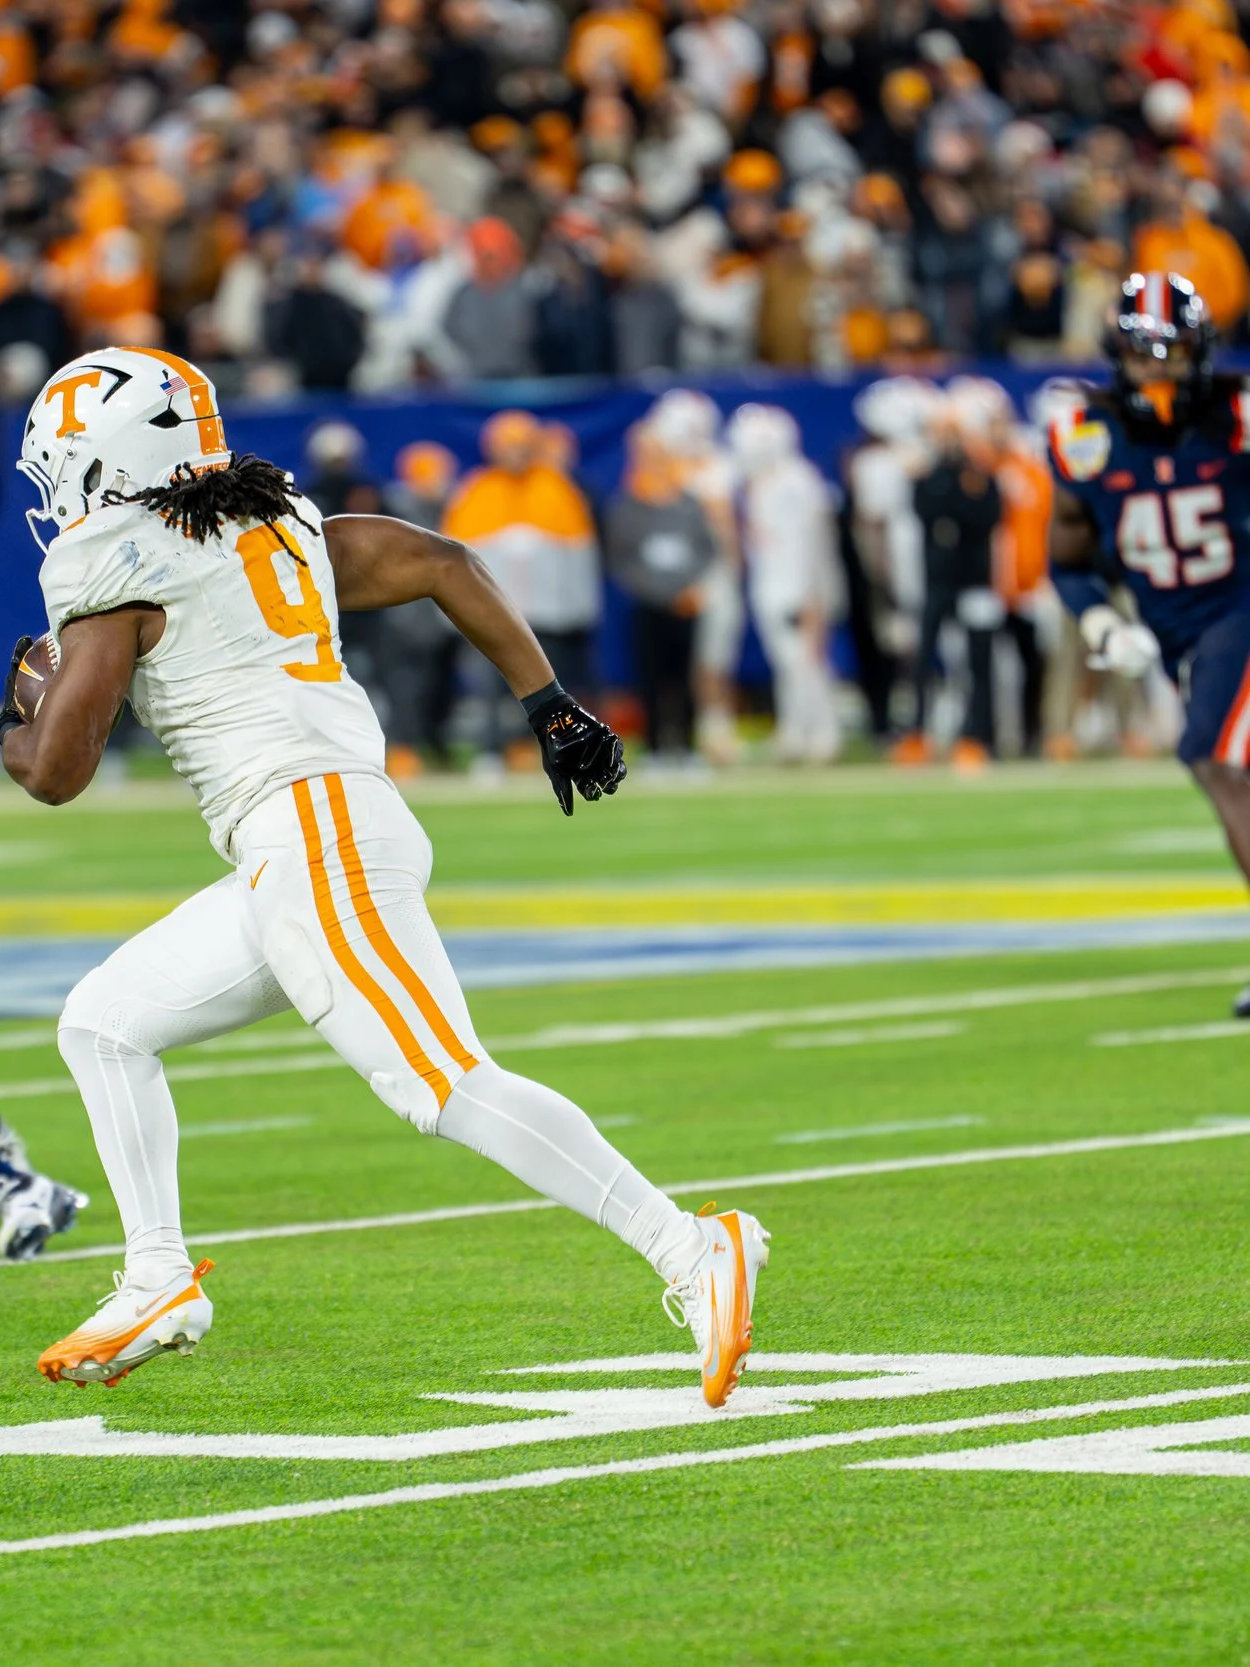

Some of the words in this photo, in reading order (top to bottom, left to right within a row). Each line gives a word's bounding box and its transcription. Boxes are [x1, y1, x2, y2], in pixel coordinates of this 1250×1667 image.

[45, 370, 103, 438] T
[1117, 482, 1234, 589] 45
[235, 522, 343, 682] 9
